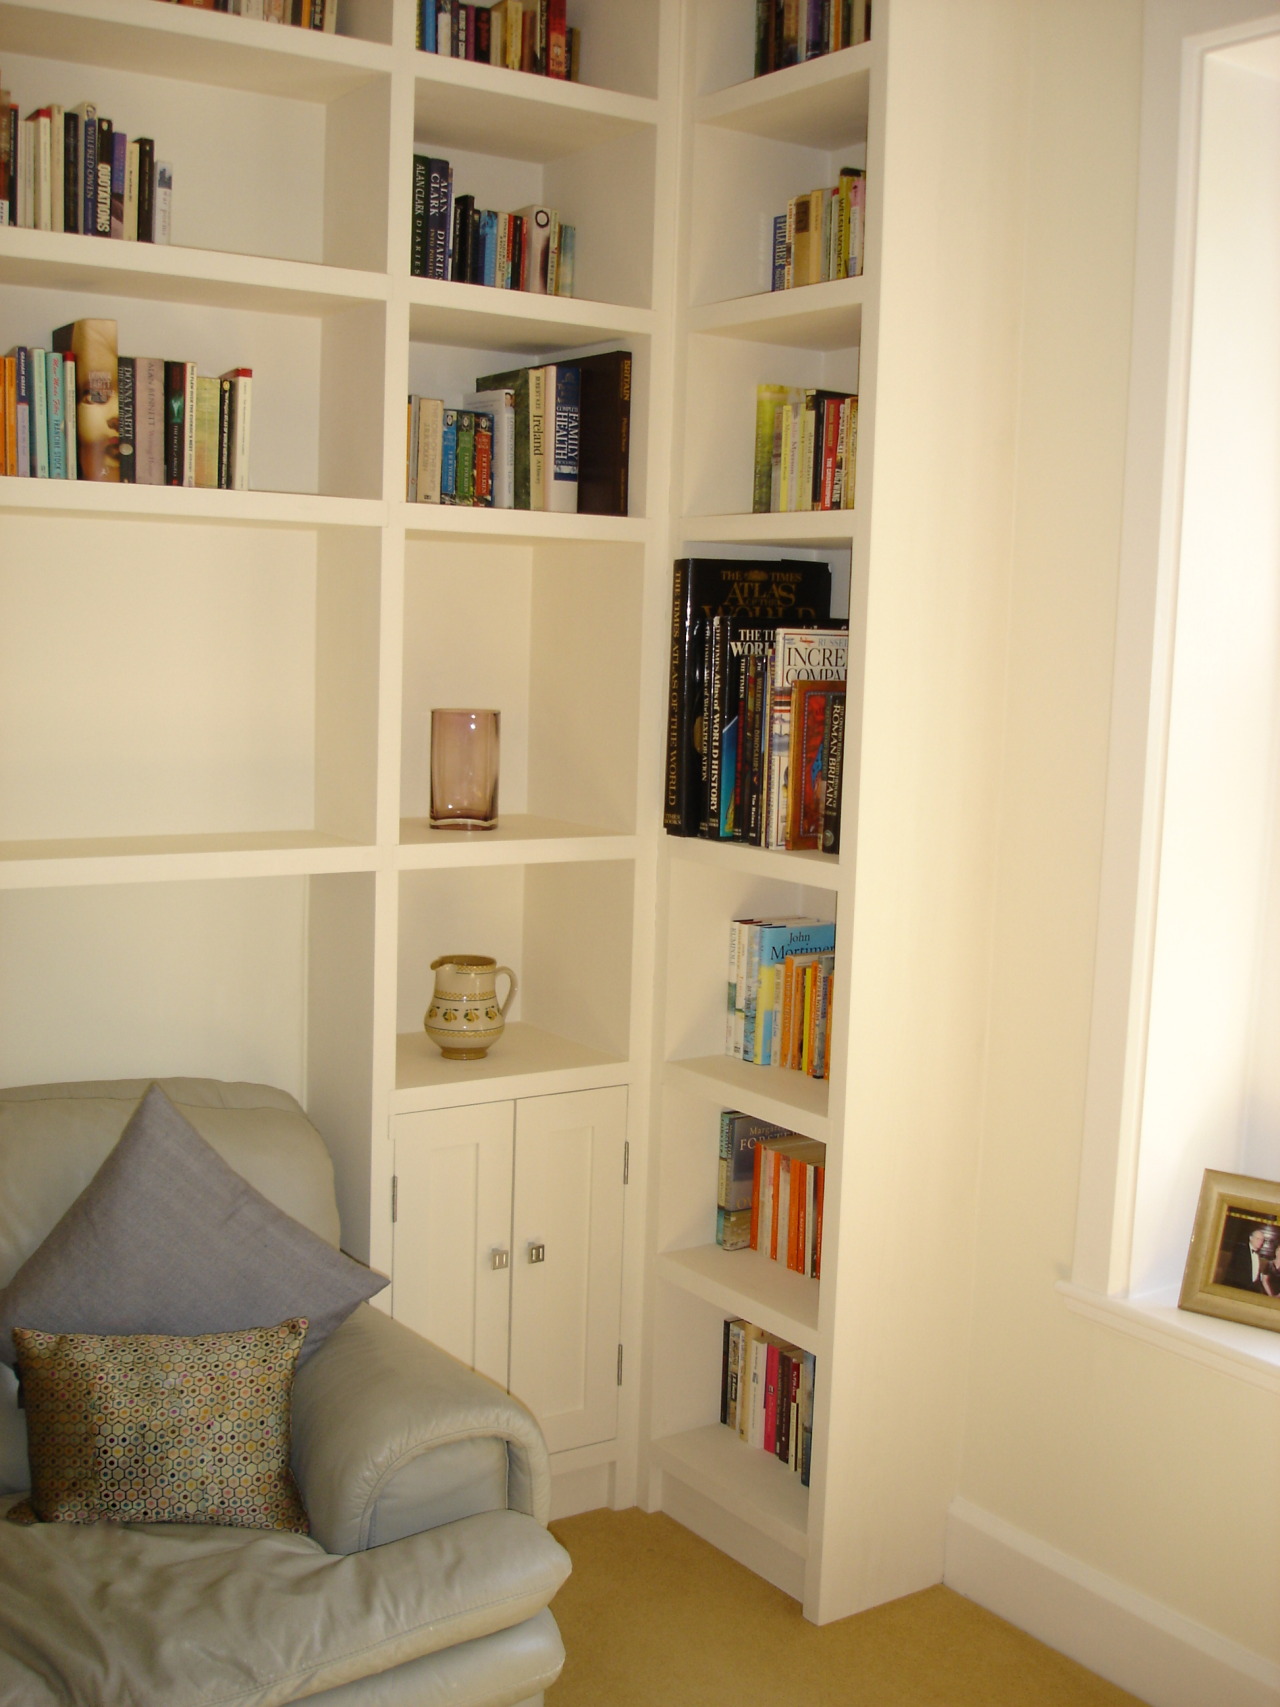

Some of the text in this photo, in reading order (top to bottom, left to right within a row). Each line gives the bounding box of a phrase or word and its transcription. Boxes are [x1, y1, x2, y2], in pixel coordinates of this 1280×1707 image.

[87, 126, 96, 168] WILFRED
[86, 169, 95, 199] OWEN
[97, 163, 111, 232] QUOTATIONS
[429, 172, 440, 216] CLARK
[440, 179, 448, 213] ALAN
[414, 163, 425, 275] ALAN CLARK DIARIES
[623, 360, 632, 401] BRITAIN
[124, 367, 133, 440] DONNA TARTT
[148, 388, 156, 426] BENNETT
[533, 414, 544, 456] Ireland
[555, 411, 568, 459] HEALTH
[567, 412, 579, 460] FAMILY
[674, 570, 682, 599] THE
[720, 571, 802, 582] THE TIMES
[722, 582, 796, 606] ATLAS
[738, 629, 761, 641] THE
[786, 647, 846, 667] INCRE
[671, 692, 679, 712] OF
[713, 699, 721, 711] of
[755, 677, 763, 712] WALKING
[670, 715, 678, 754] THE
[711, 713, 720, 758] WORLD
[830, 704, 841, 755] ROMAN
[752, 729, 760, 773] DINOSAURS
[668, 756, 678, 806] WORLD
[710, 759, 719, 813] HISTORY
[826, 757, 837, 807] BRITAIN
[789, 931, 811, 944] John
